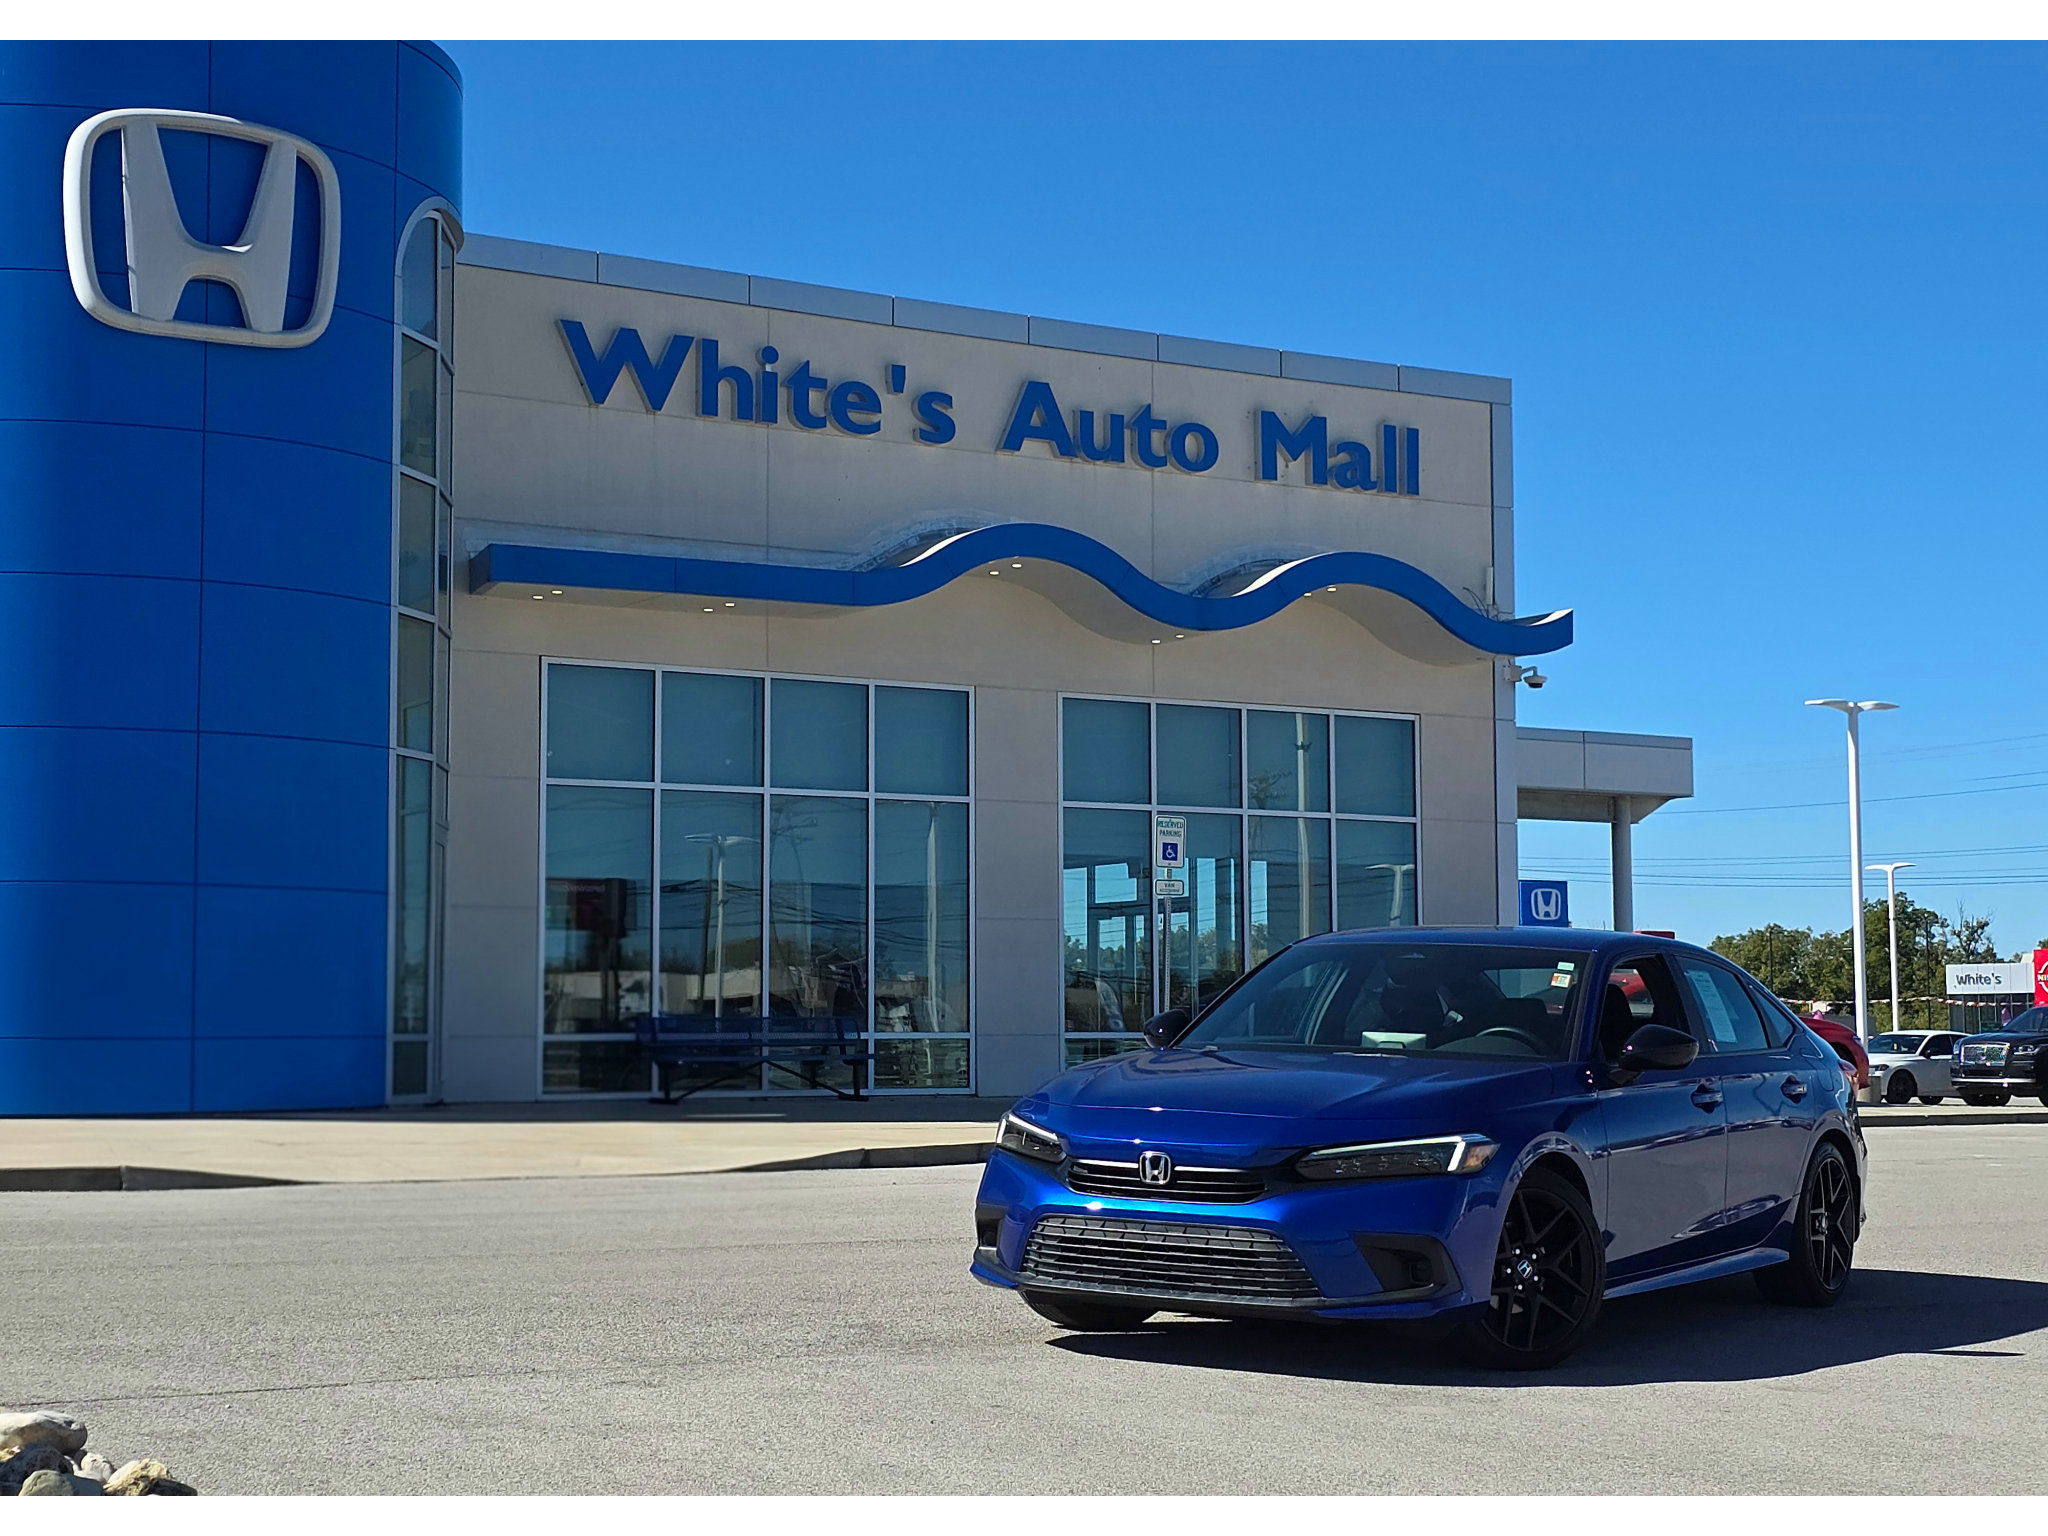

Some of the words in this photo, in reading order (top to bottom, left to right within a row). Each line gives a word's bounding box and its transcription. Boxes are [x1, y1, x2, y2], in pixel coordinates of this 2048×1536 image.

[556, 318, 957, 445] White's
[996, 380, 1219, 474] Auto
[1255, 409, 1420, 497] Mall
[1158, 820, 1184, 829] RESERVED
[1159, 829, 1182, 837] PARKING
[1956, 972, 2002, 986] White's
